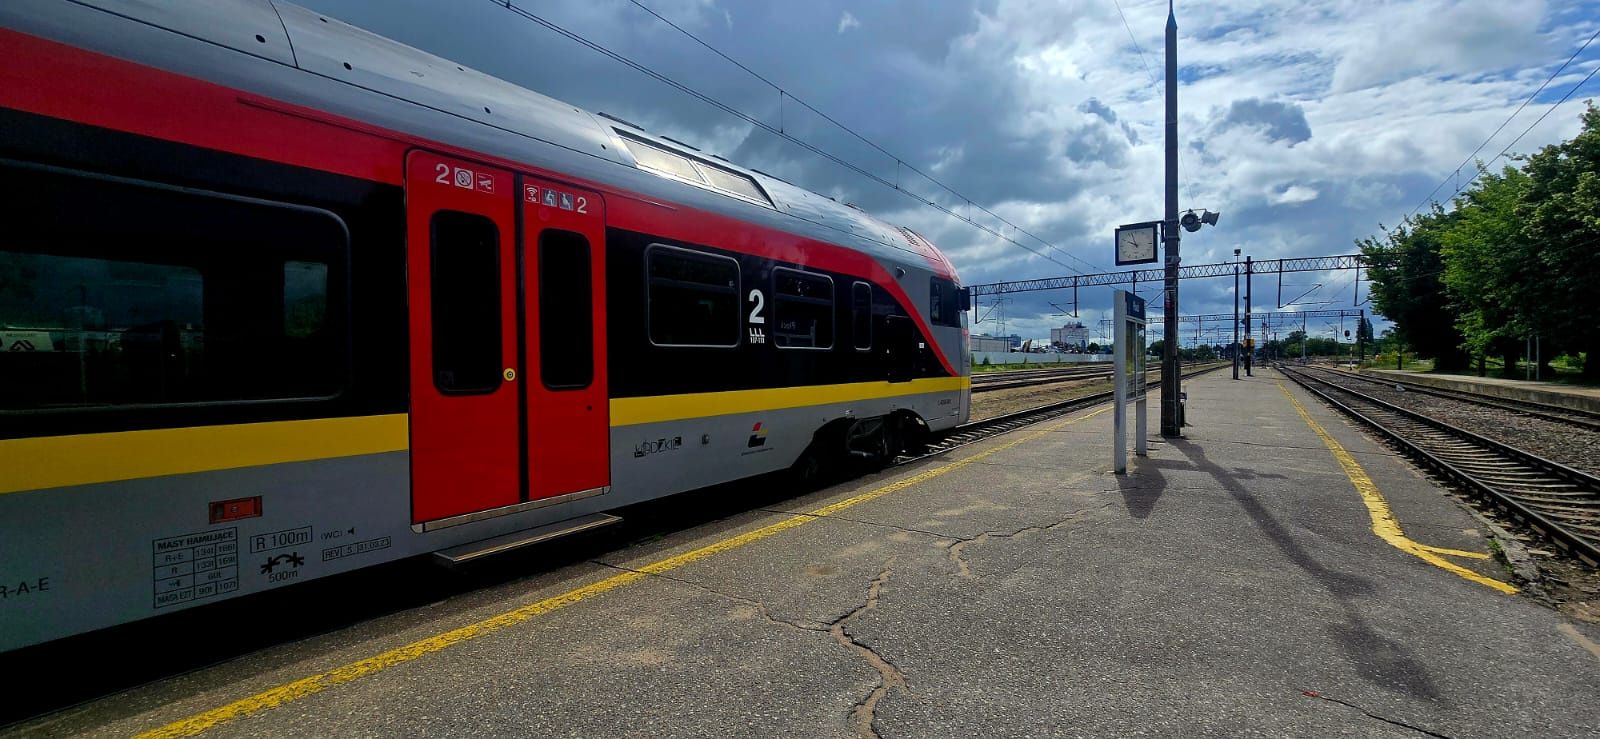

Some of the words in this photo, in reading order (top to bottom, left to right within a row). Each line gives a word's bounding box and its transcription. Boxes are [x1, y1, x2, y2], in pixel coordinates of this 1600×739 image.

[435, 163, 450, 185] 2
[577, 196, 587, 214] 2
[749, 289, 765, 324] 2
[157, 540, 185, 552] MASY
[256, 538, 265, 550] R
[271, 530, 309, 547] 100m
[268, 569, 298, 583] 500m
